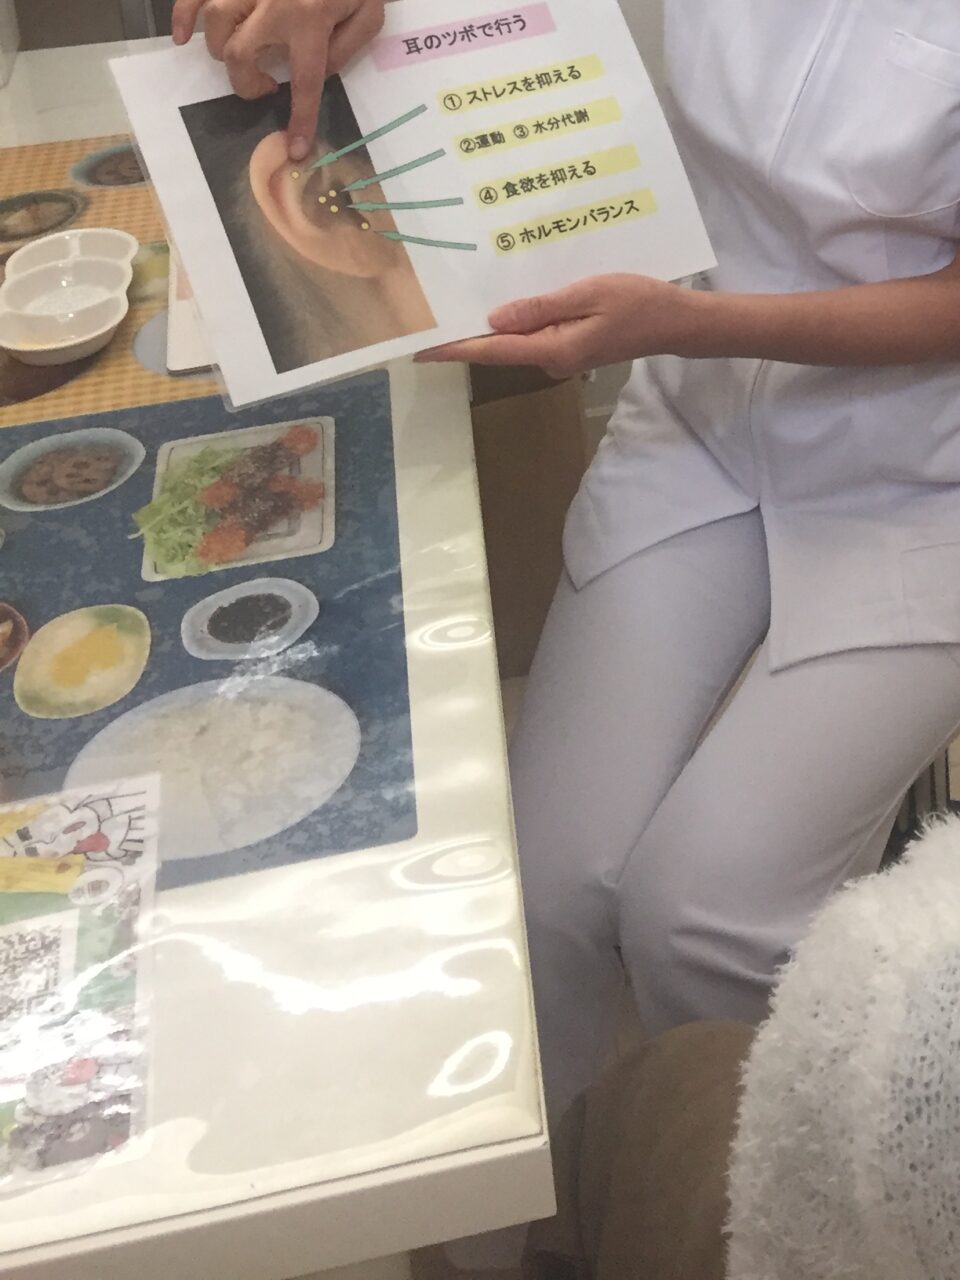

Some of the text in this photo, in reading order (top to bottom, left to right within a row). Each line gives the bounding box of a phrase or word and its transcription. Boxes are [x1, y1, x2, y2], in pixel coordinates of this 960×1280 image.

[402, 14, 527, 56] 耳のツボで行う
[466, 65, 582, 104] ストレスを抑える
[532, 108, 590, 134] 水分代謝
[502, 160, 597, 198] 食欲を抑える
[519, 200, 640, 243] ホルモンバランス
